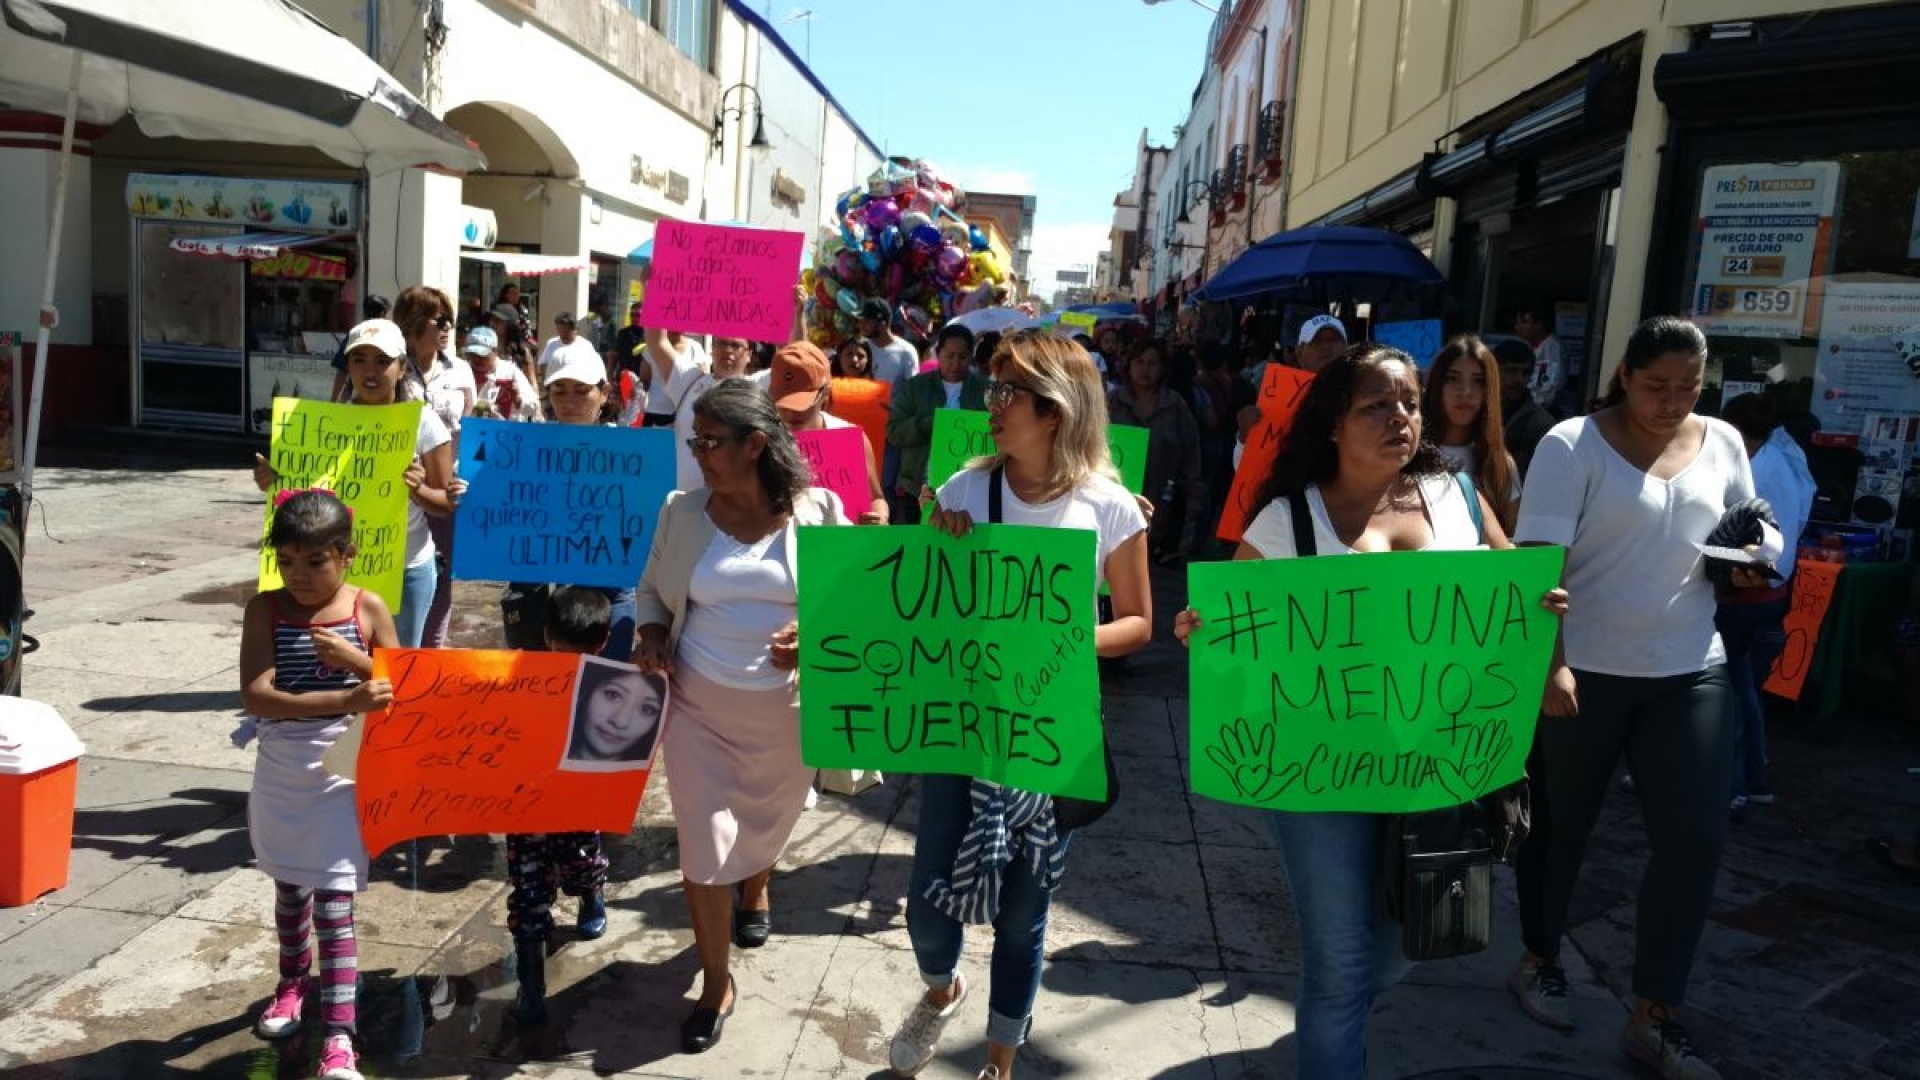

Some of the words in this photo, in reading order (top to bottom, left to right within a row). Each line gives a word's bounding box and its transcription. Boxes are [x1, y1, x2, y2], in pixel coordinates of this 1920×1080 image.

[671, 228, 692, 249] No
[703, 231, 778, 259] estamos
[1713, 233, 1756, 243] PRECIO
[1759, 233, 1775, 243] DE
[1776, 233, 1804, 243] ORO
[1738, 244, 1783, 254] GRAMO
[1727, 260, 1749, 273] 24
[277, 411, 307, 447] El
[312, 416, 411, 452] feminismo
[276, 448, 340, 478] nunca
[353, 453, 375, 479] ha
[537, 442, 643, 477] mañana
[378, 481, 391, 499] a
[508, 480, 549, 506] me
[561, 475, 625, 510] toca
[471, 502, 549, 539] quiero
[567, 511, 606, 535] ser
[619, 506, 643, 538] la
[865, 543, 1073, 625] UNIDAS
[1207, 586, 1370, 661] #NI
[1406, 580, 1528, 648] UNA
[809, 633, 1003, 694] SOMOS
[1270, 660, 1519, 732] MENOS
[829, 700, 1063, 767] FUERTES
[362, 790, 398, 826] mi
